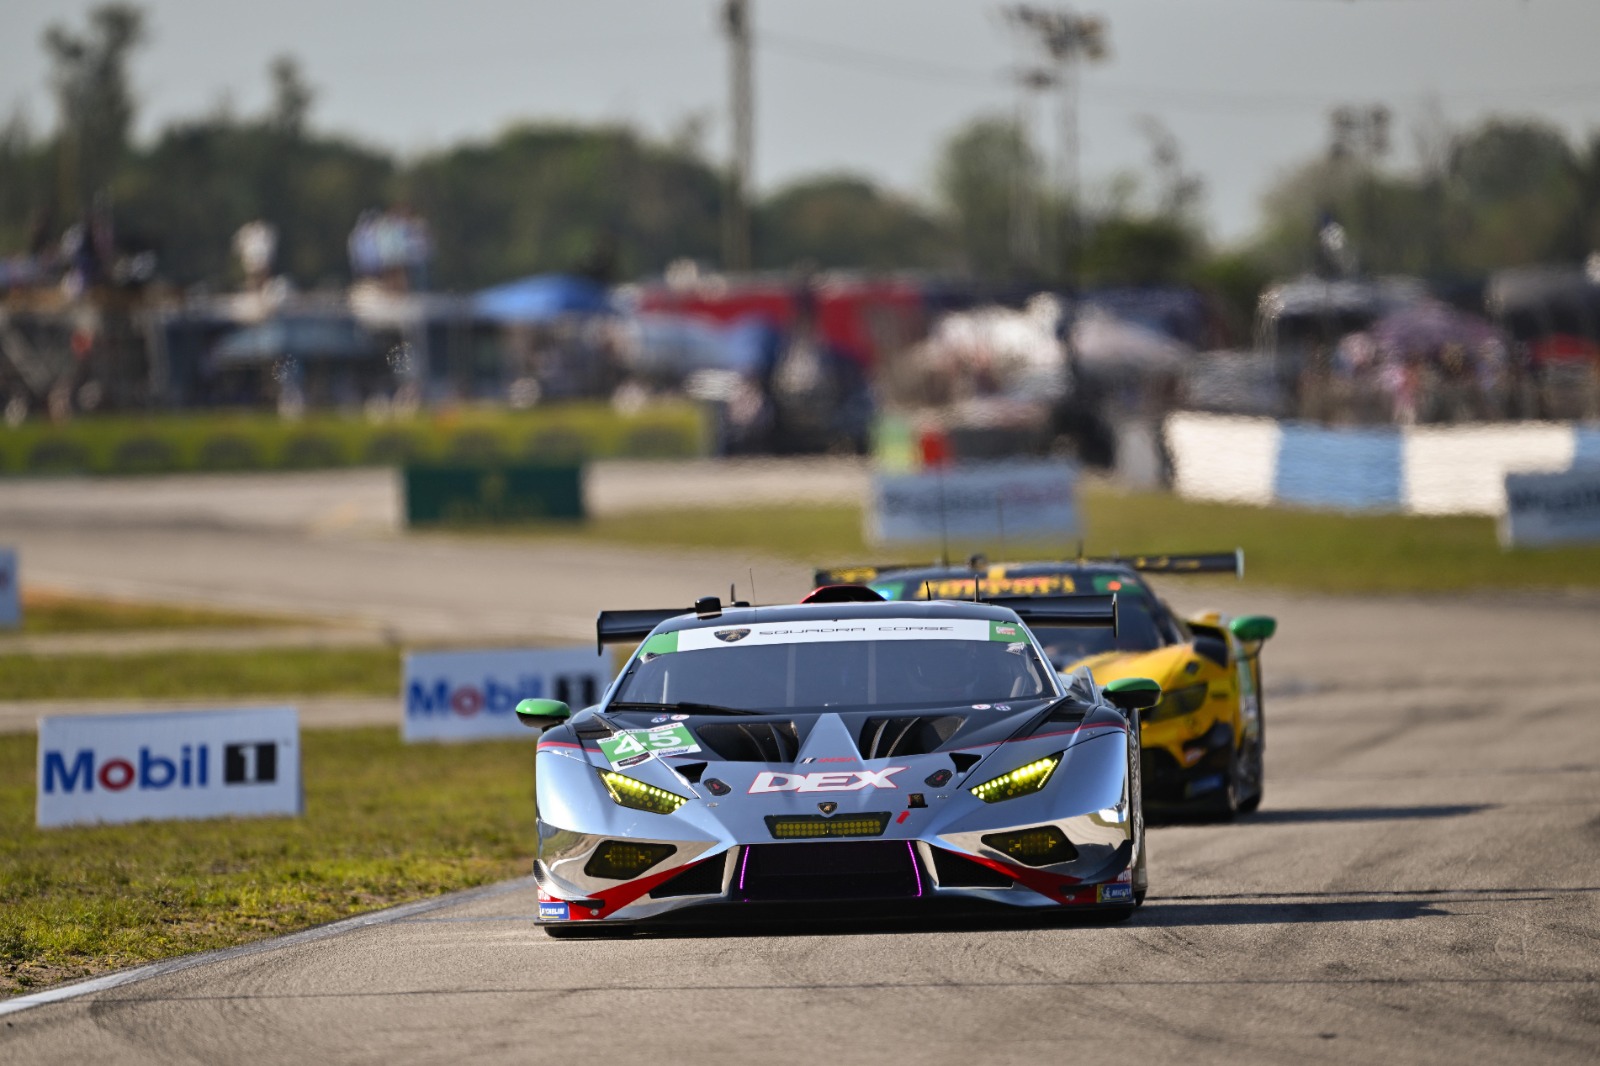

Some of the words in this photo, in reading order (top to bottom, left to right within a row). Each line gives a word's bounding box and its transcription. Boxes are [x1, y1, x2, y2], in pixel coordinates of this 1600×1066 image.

[759, 627, 866, 635] SQUADRA
[407, 672, 544, 720] Mobil
[613, 730, 682, 755] 45
[43, 744, 208, 794] Mobil
[747, 766, 909, 794] DEX
